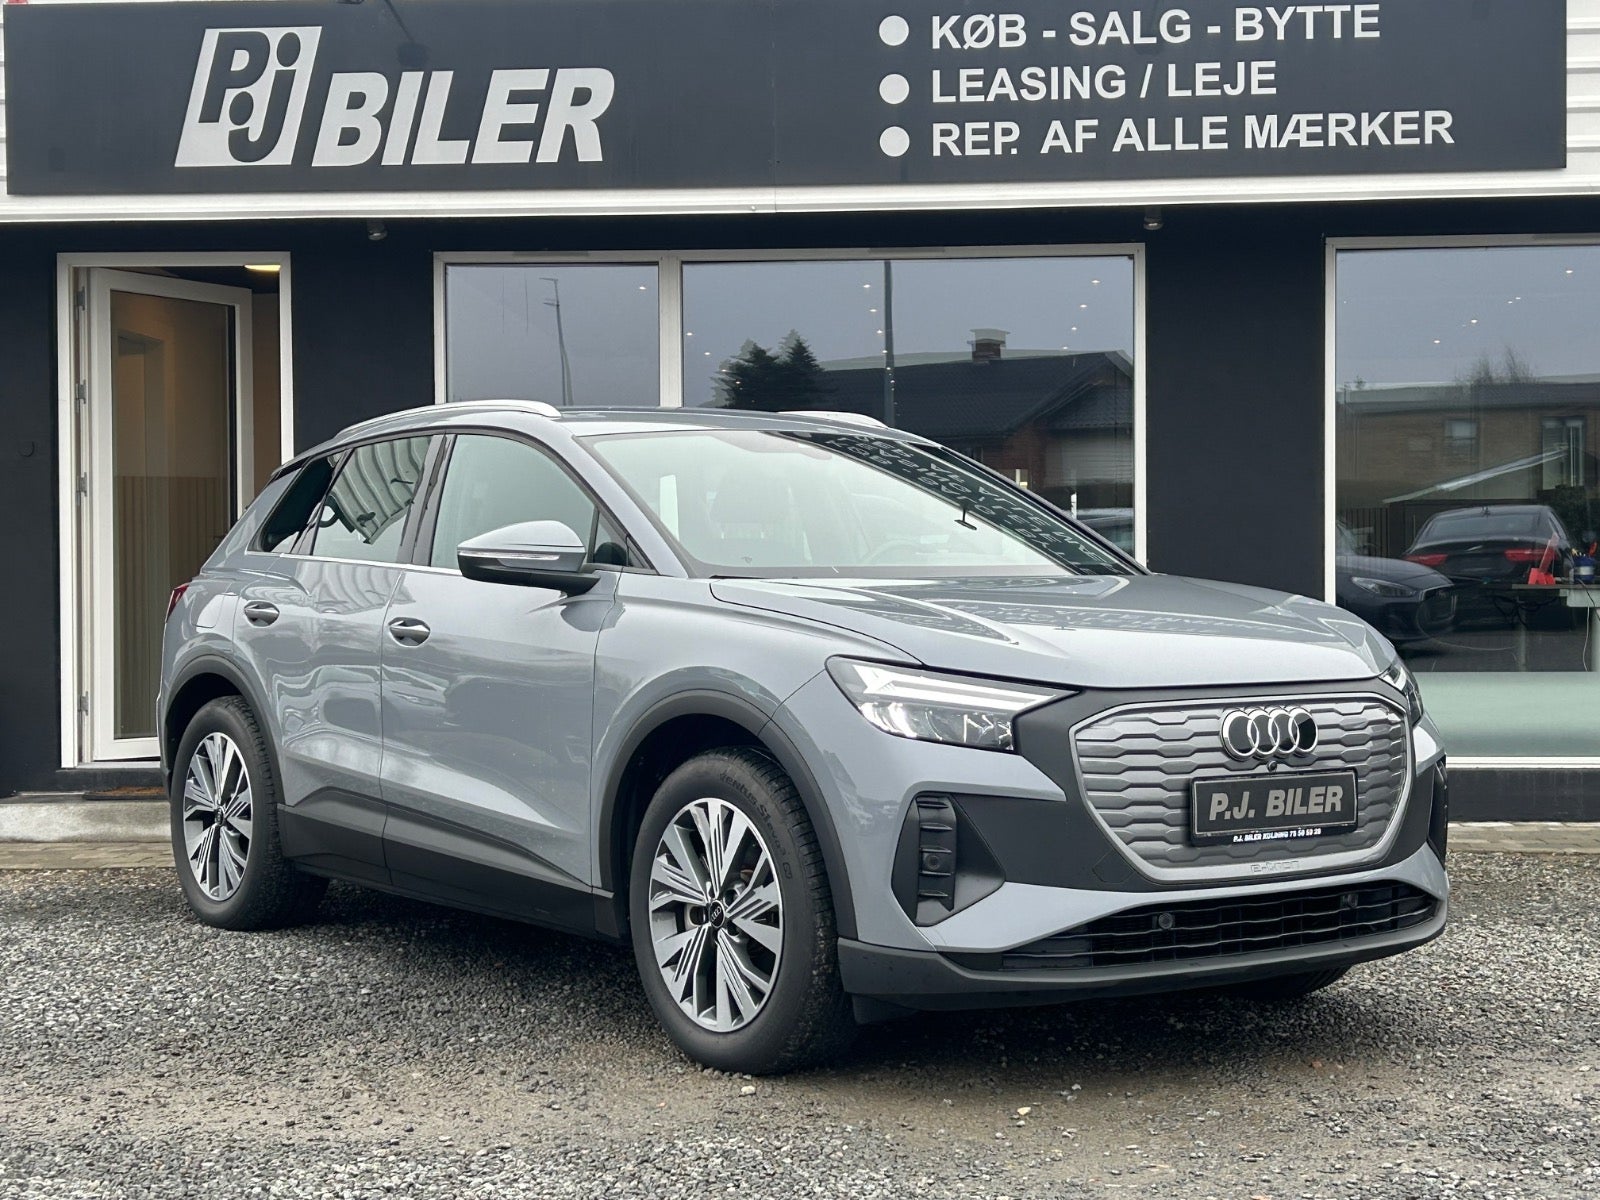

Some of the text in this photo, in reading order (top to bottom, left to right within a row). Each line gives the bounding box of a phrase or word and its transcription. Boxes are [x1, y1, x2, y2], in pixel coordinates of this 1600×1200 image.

[932, 13, 1027, 50] KØB
[1068, 9, 1191, 47] SALG
[1235, 3, 1381, 42] BYTTE
[932, 64, 1126, 103] LEASING
[1167, 60, 1277, 97] LEJE
[312, 68, 615, 167] BILER
[932, 110, 1455, 157] REP. AF ALLE MÆRKER
[1209, 785, 1344, 822] P.J. BILER
